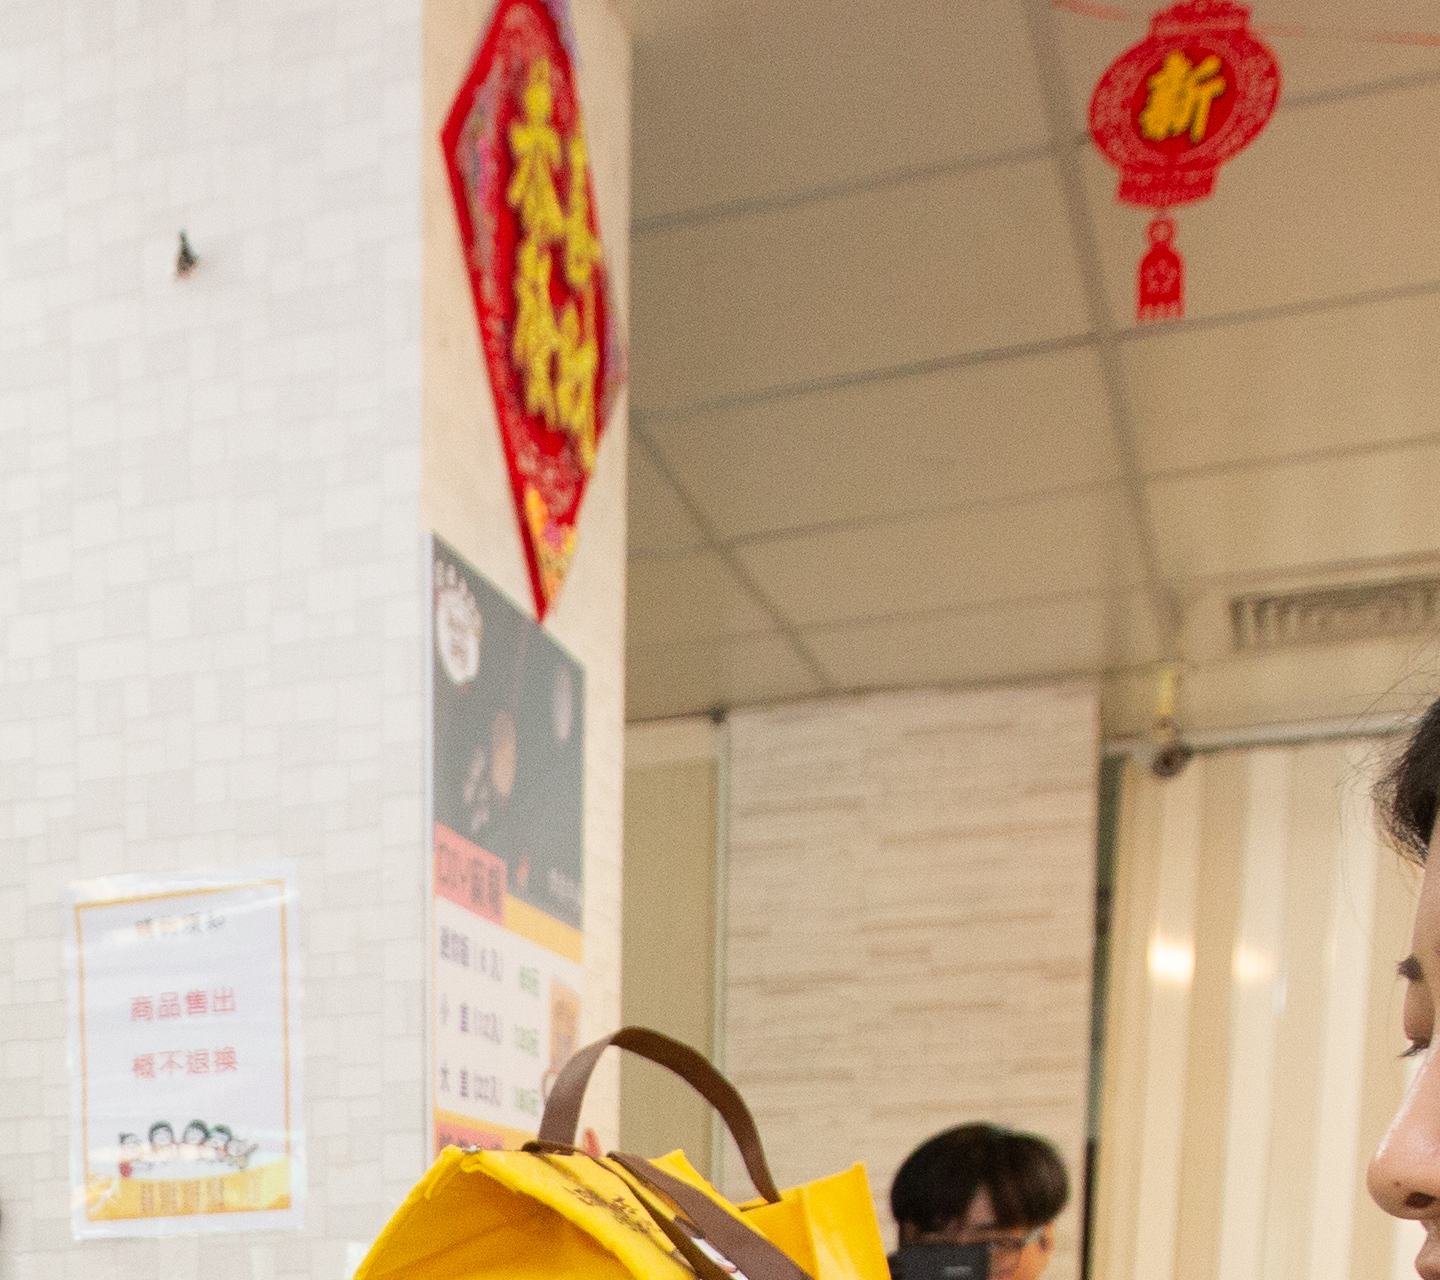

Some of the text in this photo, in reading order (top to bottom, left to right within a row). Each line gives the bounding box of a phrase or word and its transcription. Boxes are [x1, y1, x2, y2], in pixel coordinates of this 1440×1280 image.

[1138, 49, 1226, 144] 新
[129, 986, 237, 1022] 商品售出
[132, 1046, 238, 1080] 概不退換
